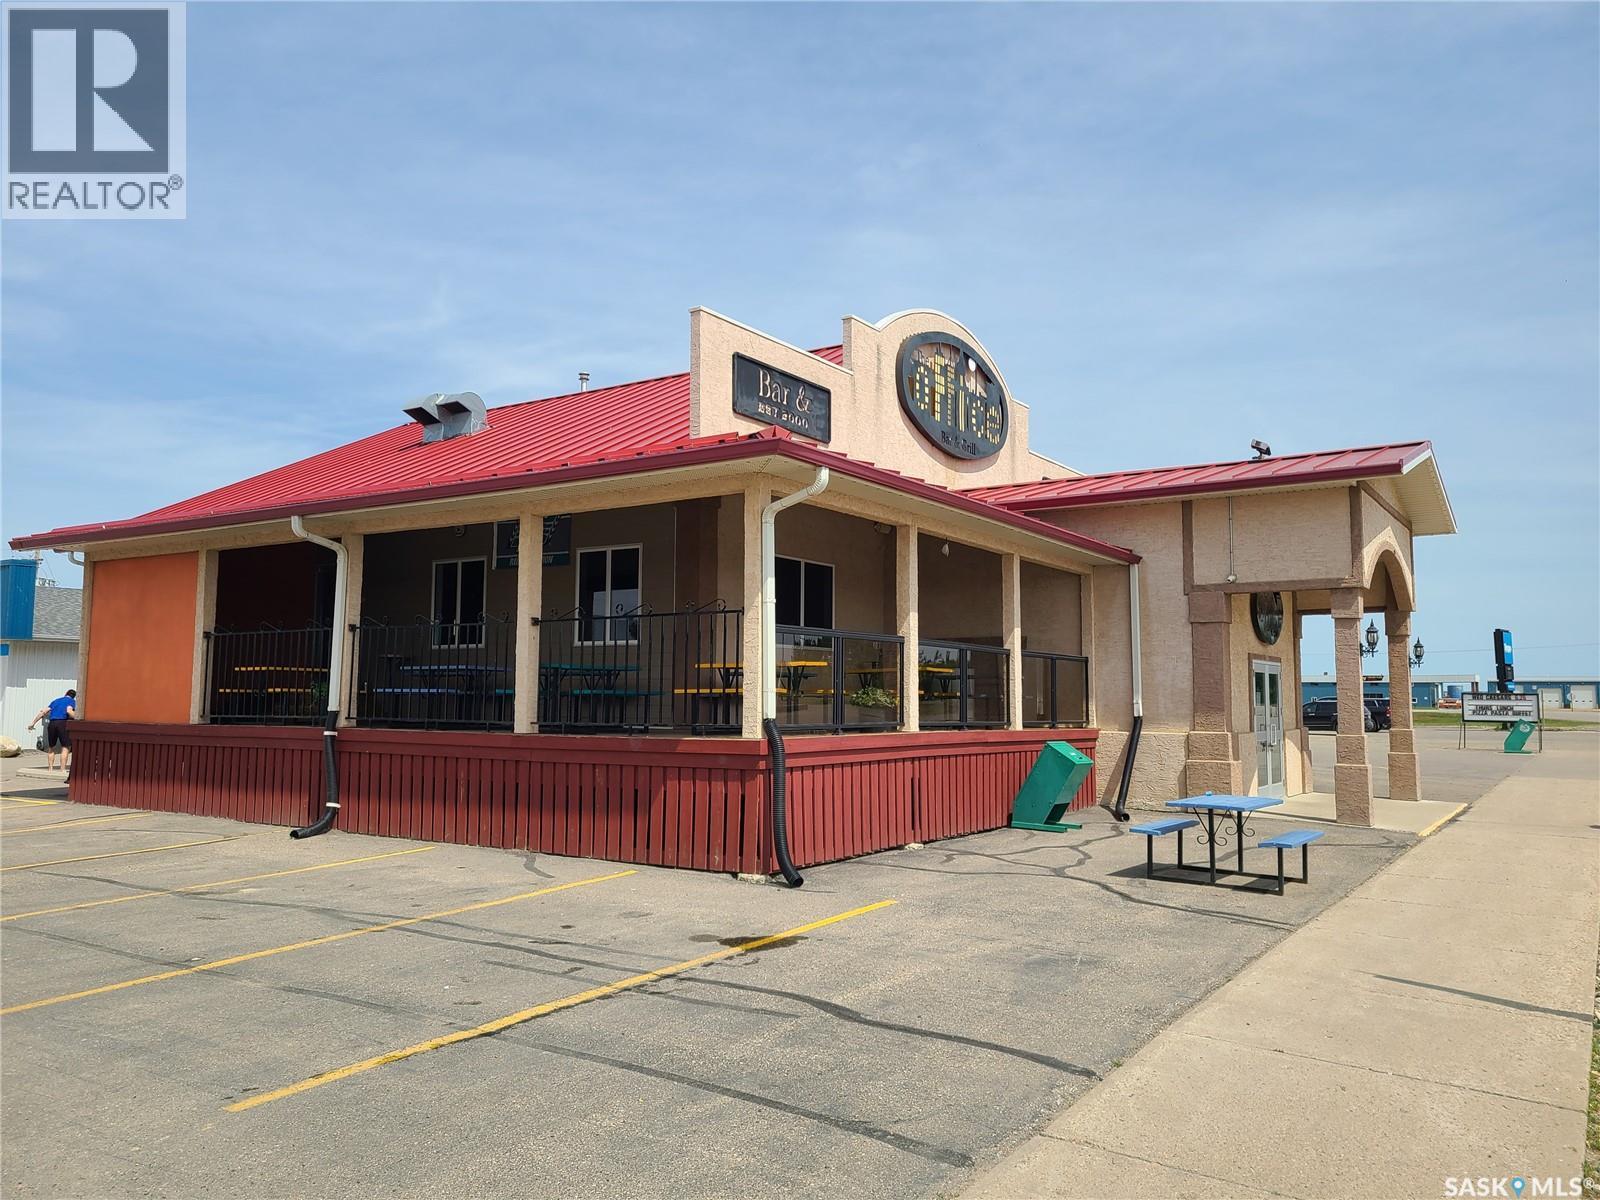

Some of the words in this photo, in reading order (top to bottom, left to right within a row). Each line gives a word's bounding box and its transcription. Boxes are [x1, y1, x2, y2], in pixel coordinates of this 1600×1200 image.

[758, 368, 791, 406] Bar
[795, 385, 814, 414] &
[758, 401, 780, 418] EST
[941, 430, 953, 446] Bar
[961, 438, 976, 456] Grill
